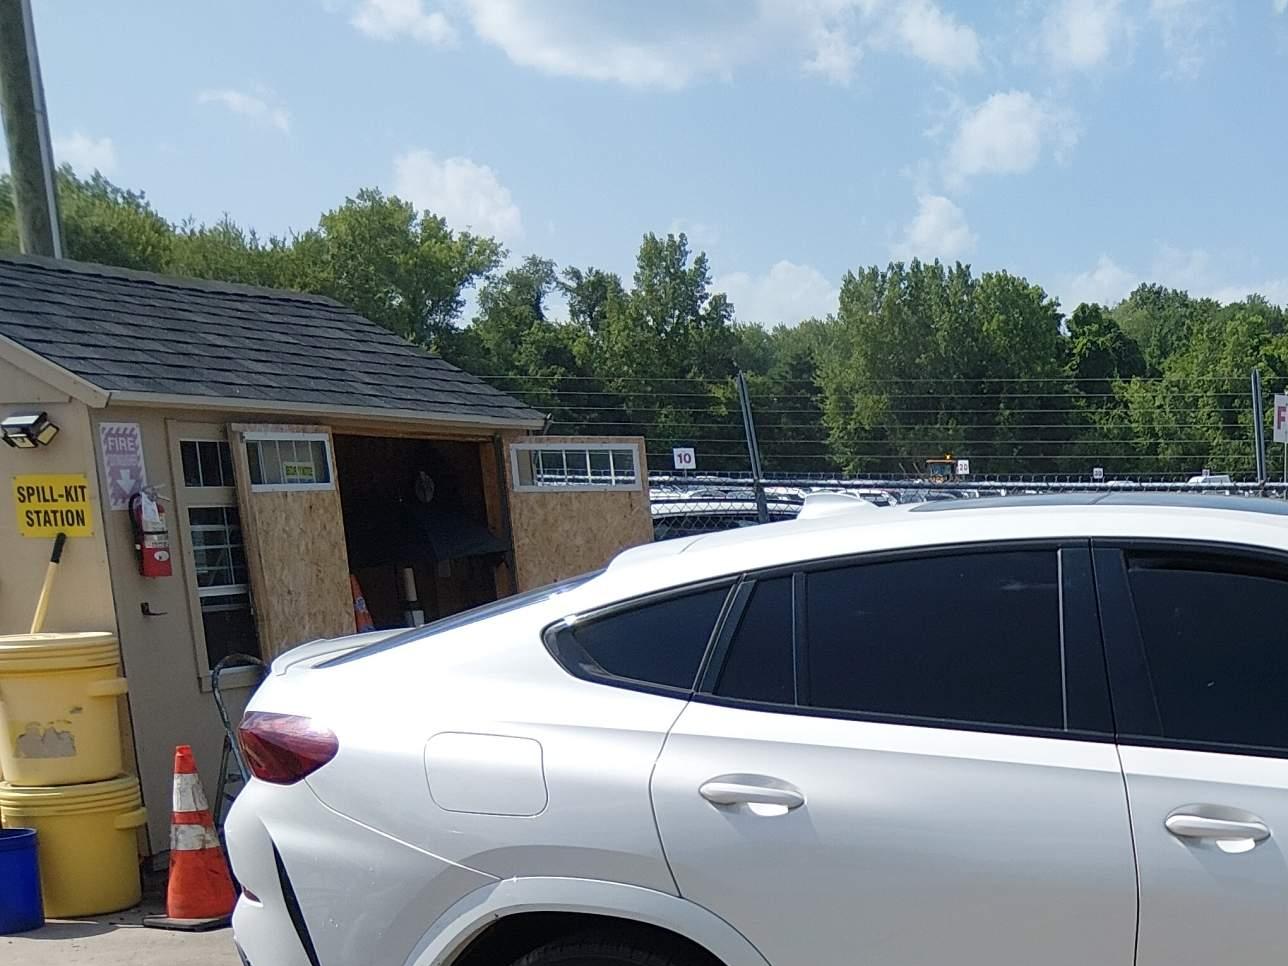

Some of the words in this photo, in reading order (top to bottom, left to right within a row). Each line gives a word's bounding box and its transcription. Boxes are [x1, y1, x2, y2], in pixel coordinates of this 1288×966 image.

[108, 437, 136, 452] FIRE
[677, 453, 692, 464] 10
[17, 485, 87, 504] SPILL-KIT
[25, 508, 86, 528] STATION
